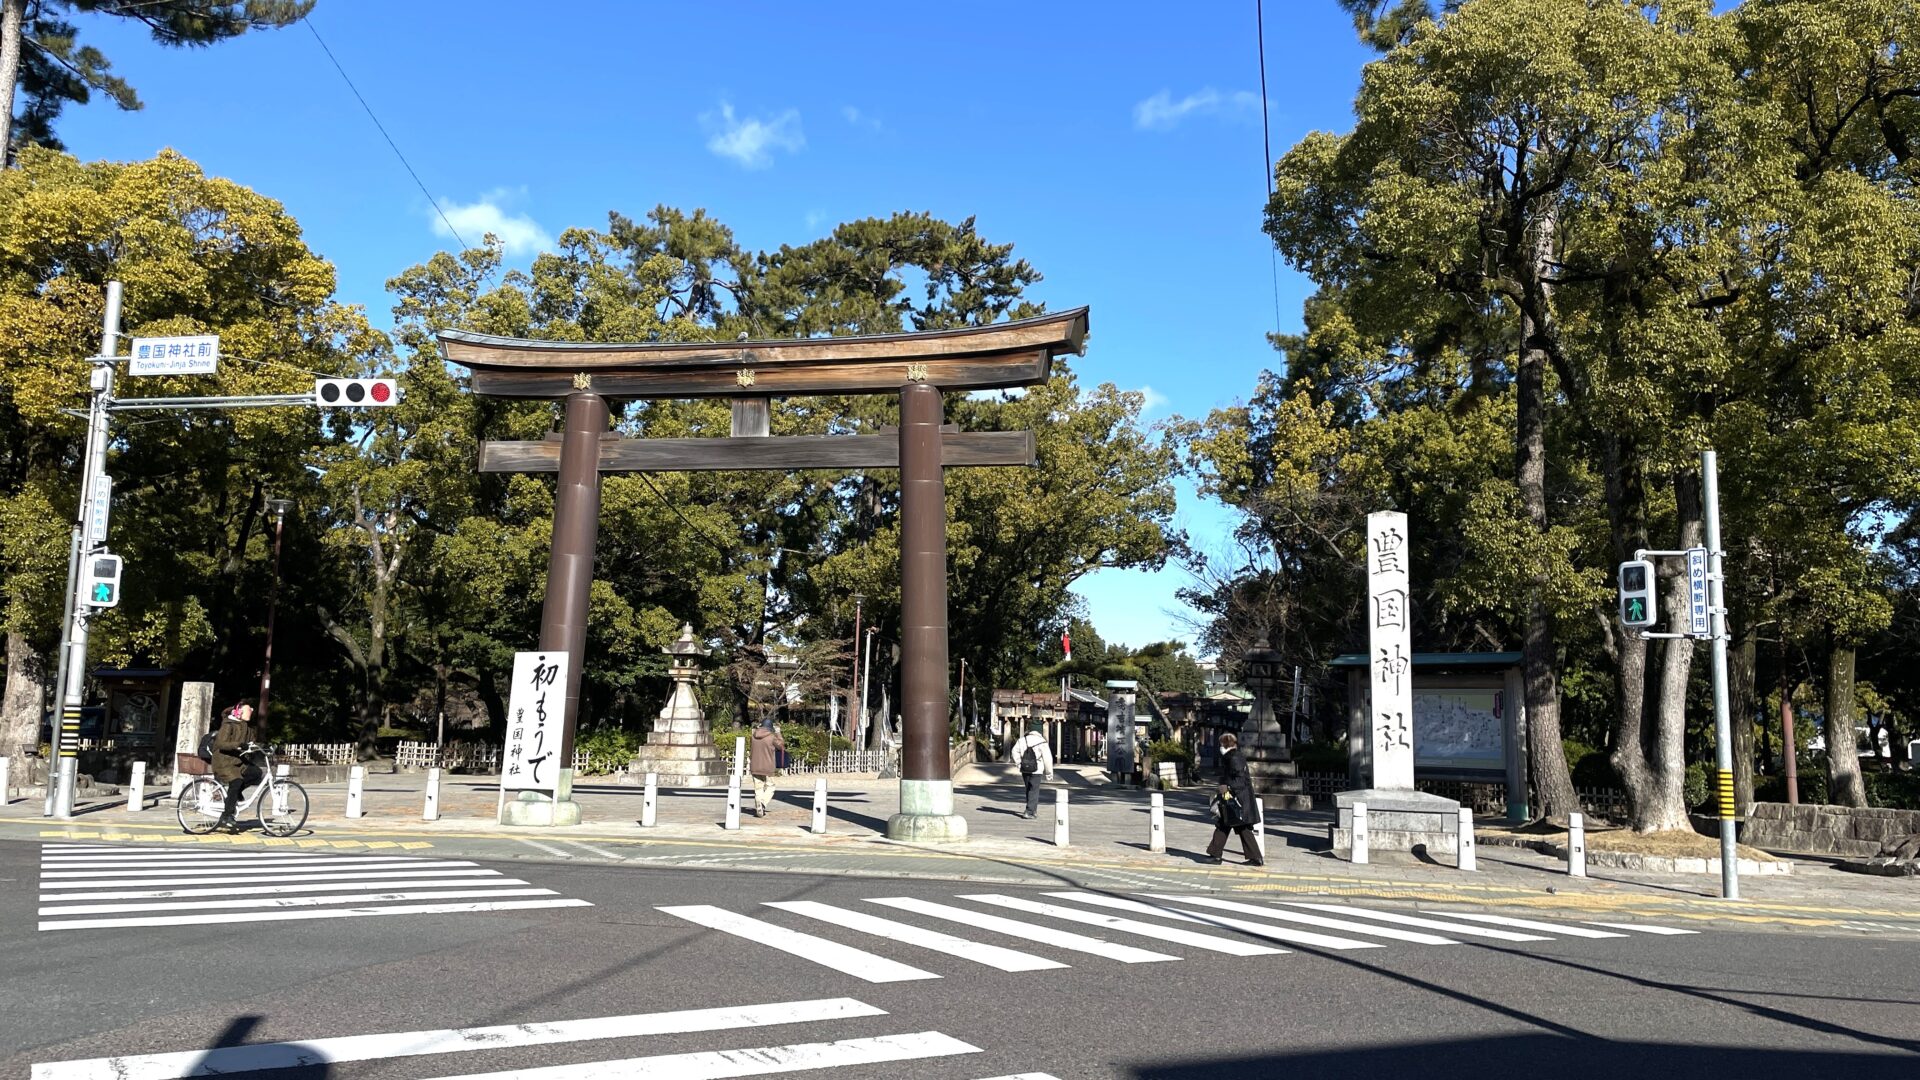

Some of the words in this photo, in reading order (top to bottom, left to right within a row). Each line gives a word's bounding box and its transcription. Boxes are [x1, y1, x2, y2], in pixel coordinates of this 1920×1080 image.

[138, 343, 211, 359] 豊国神社前
[189, 360, 210, 368] Shrine
[1692, 555, 1704, 627] 斜め横断専用
[1373, 528, 1409, 751] 豊国神社
[509, 708, 524, 775] 豊国神社
[528, 655, 559, 783] 初もうで
